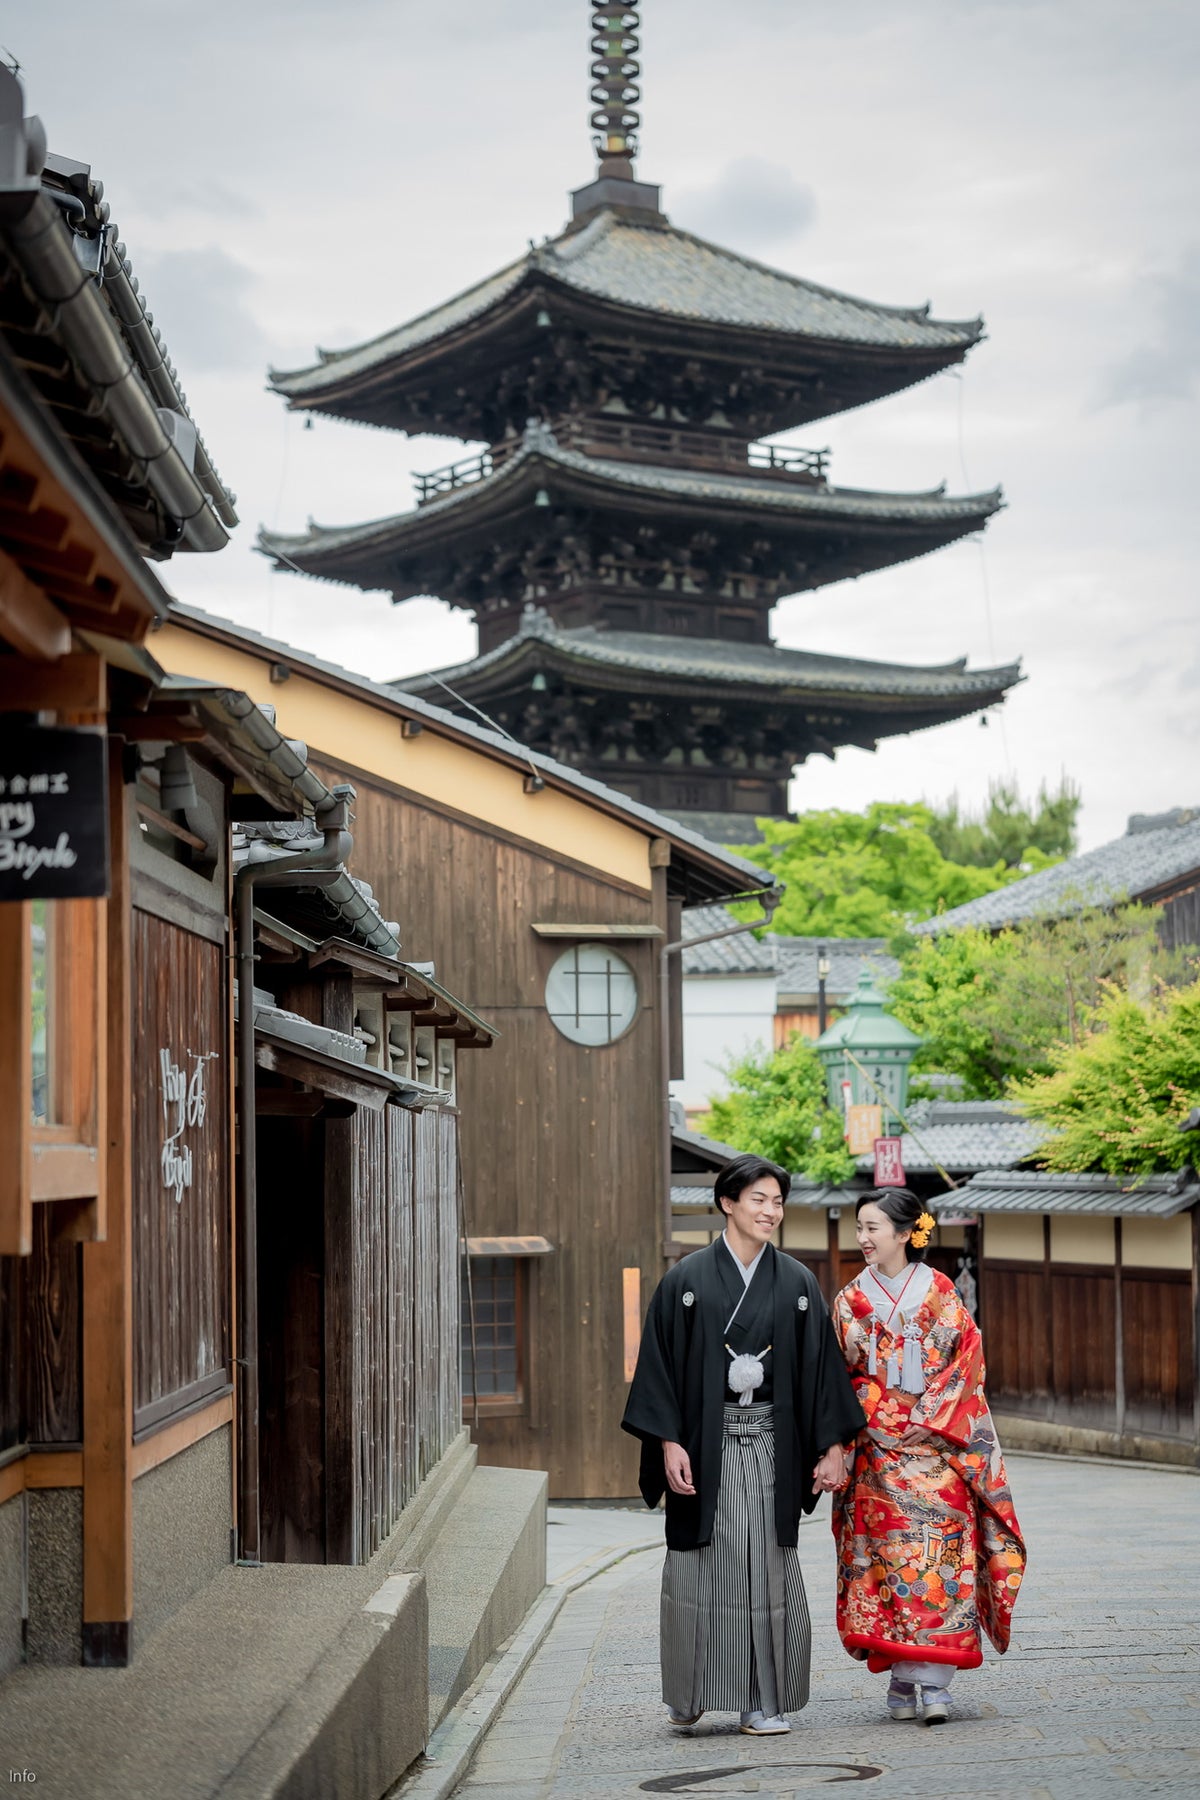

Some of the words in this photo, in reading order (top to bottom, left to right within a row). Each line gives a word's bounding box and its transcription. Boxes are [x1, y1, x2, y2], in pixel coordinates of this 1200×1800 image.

[0, 772, 69, 795] 金細工
[0, 800, 35, 840] py
